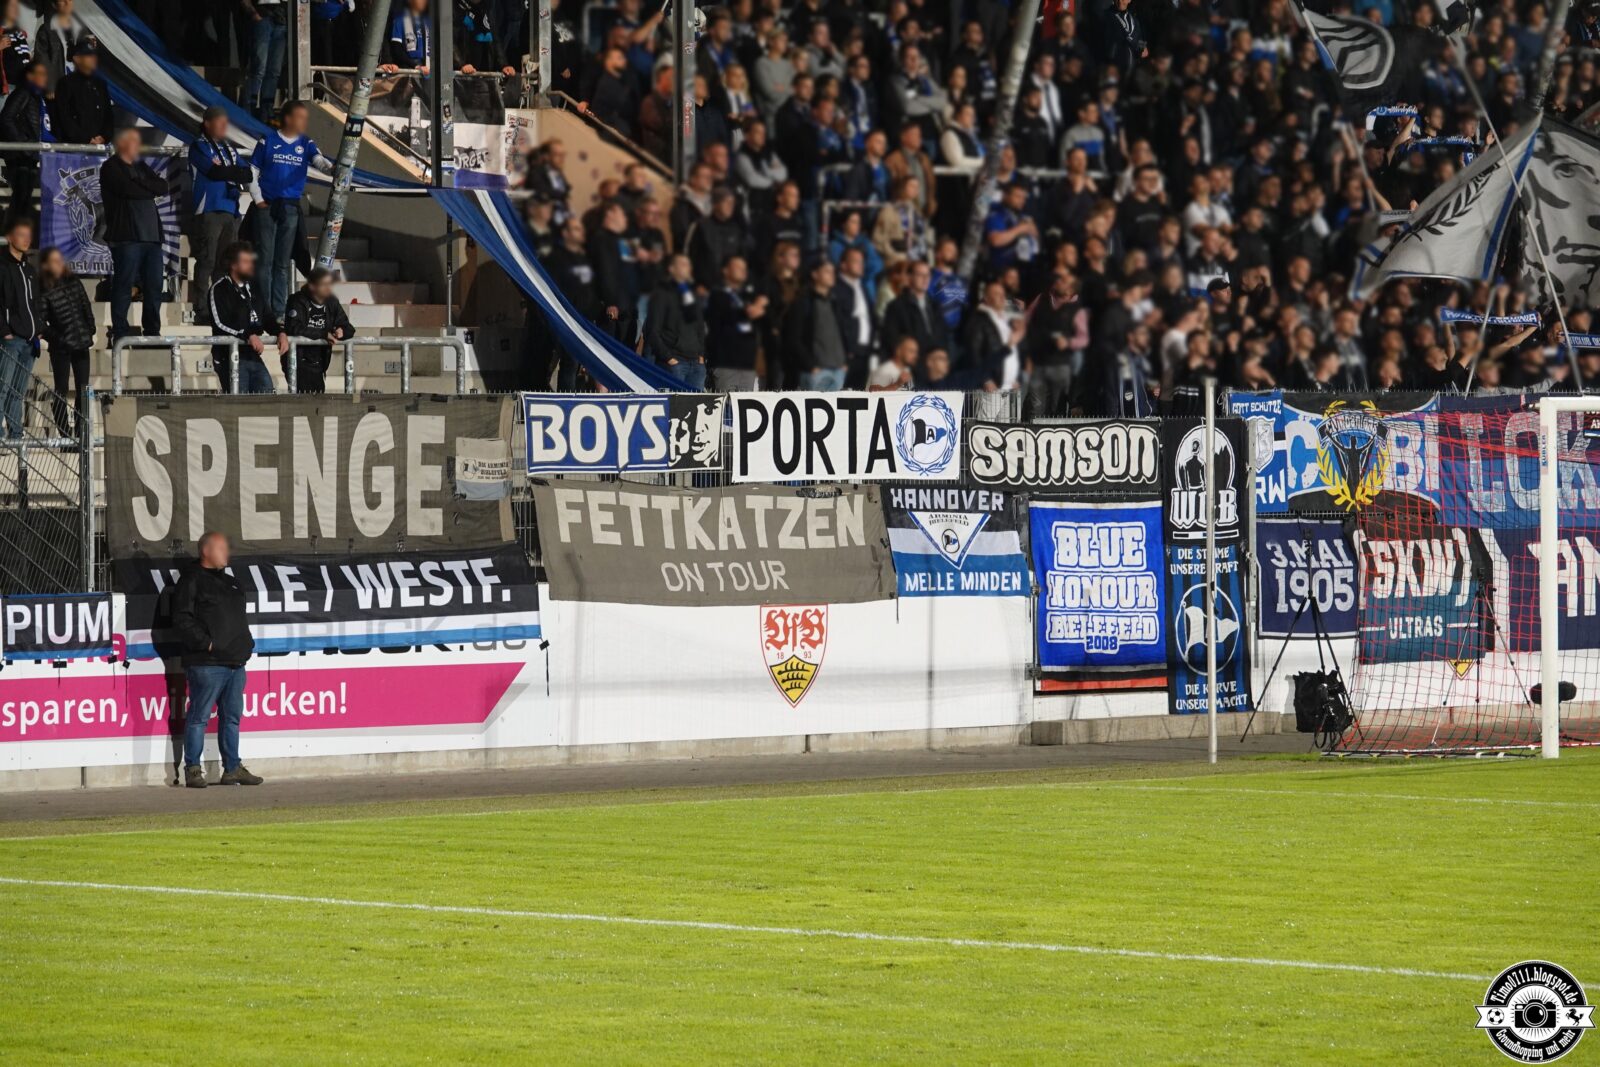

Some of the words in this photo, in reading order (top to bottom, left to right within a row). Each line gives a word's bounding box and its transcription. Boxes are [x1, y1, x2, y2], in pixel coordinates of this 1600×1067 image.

[273, 153, 303, 162] SCHÜCO
[1250, 399, 1282, 414] SCHÜTZE
[529, 403, 667, 468] BOYS
[737, 397, 897, 476] PORTA
[969, 423, 1159, 480] SAMSON
[132, 411, 446, 541] SPENGE
[890, 488, 1004, 511] HANNOVER
[554, 488, 866, 550] FETTKATZEN
[928, 513, 968, 521] ARMINIA
[1056, 526, 1144, 567] BLUE
[1177, 548, 1194, 560] DIE
[340, 558, 511, 609] WESTF.
[661, 562, 704, 592] ON
[706, 560, 789, 591] TOUR
[905, 572, 955, 591] MELLE
[961, 572, 1021, 591] MINDEN
[1170, 563, 1206, 575] UNSERE
[1215, 561, 1238, 574] RAFT
[1051, 575, 1156, 609] HONOUR
[1275, 568, 1355, 613] 1905
[6, 601, 110, 646] PIUM
[764, 608, 825, 652] VfB
[1050, 614, 1157, 641] BIELEFELD
[1389, 615, 1443, 640] ULTRAS
[776, 652, 784, 660] 18
[803, 651, 812, 659] 93
[1086, 635, 1118, 651] 2008
[1185, 684, 1200, 695] DIE
[1203, 681, 1237, 694] KRVE
[1, 697, 128, 735] sparen,
[209, 682, 347, 719] ucken!
